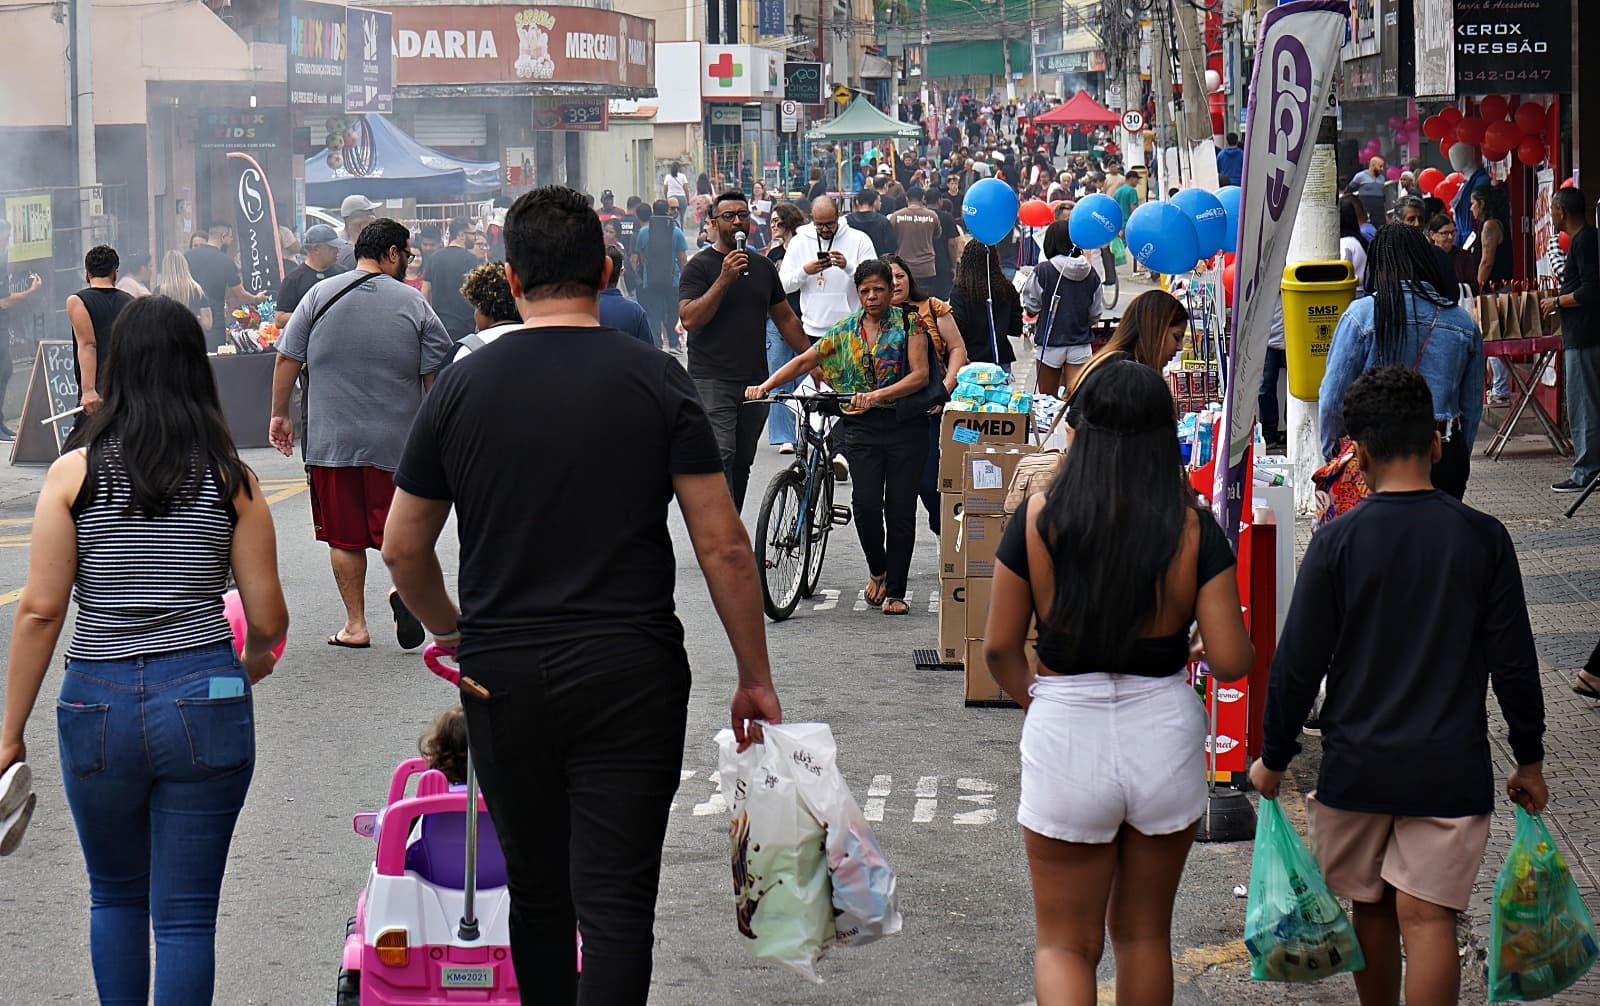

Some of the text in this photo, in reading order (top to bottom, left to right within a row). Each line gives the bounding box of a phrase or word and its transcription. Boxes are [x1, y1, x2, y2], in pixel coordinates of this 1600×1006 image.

[786, 104, 793, 112] E
[1126, 114, 1140, 124] 30
[1308, 305, 1339, 315] SMSP
[48, 346, 74, 371] Pro
[50, 374, 78, 396] Tab
